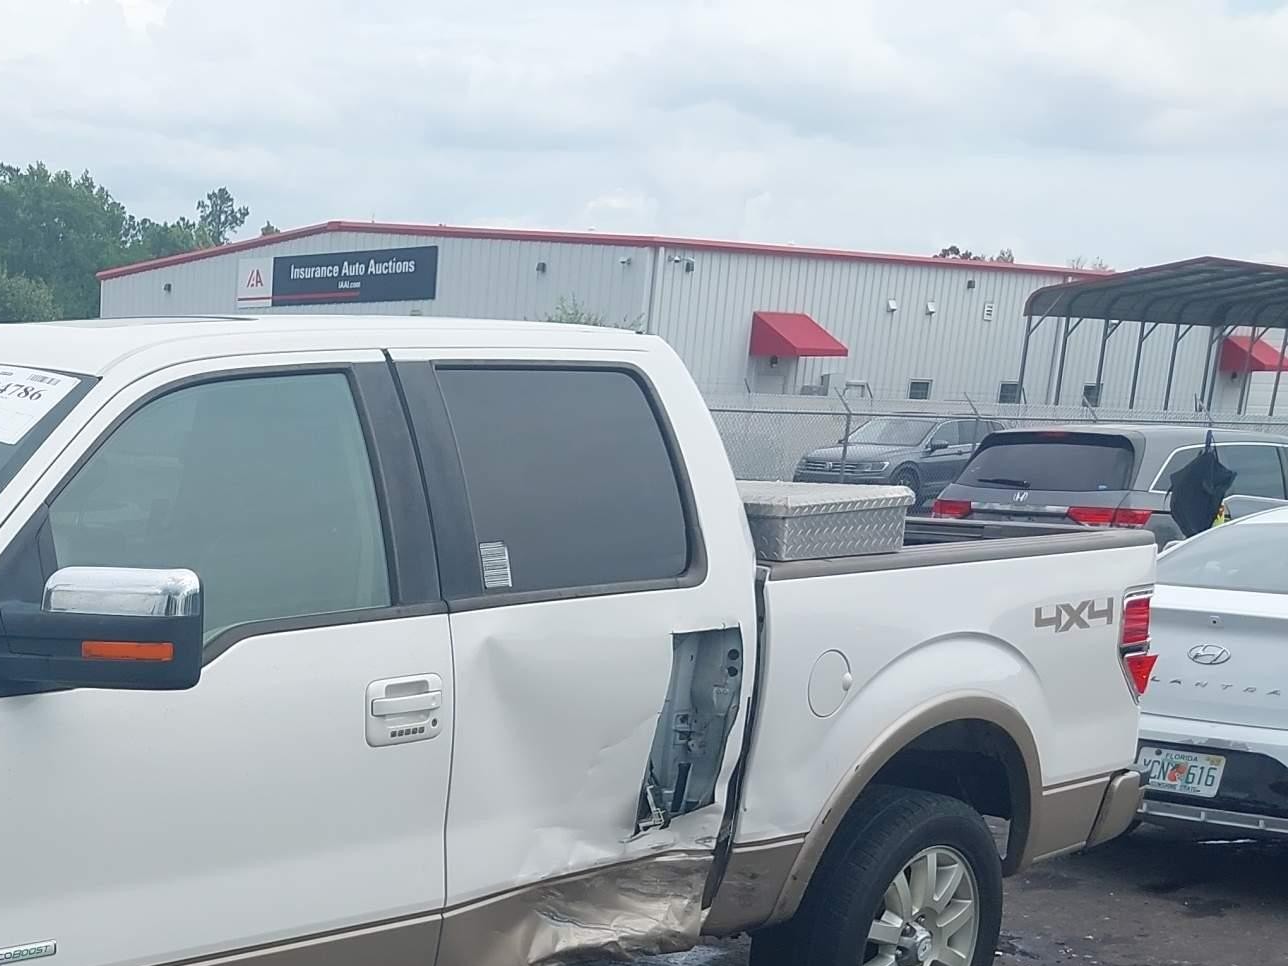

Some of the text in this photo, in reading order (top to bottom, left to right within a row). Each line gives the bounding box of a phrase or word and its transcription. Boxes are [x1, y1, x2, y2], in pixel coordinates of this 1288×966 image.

[290, 256, 416, 280] Insurance Auto Auctions
[338, 280, 361, 289] IAAI.com
[1165, 751, 1199, 762] FLORIDA
